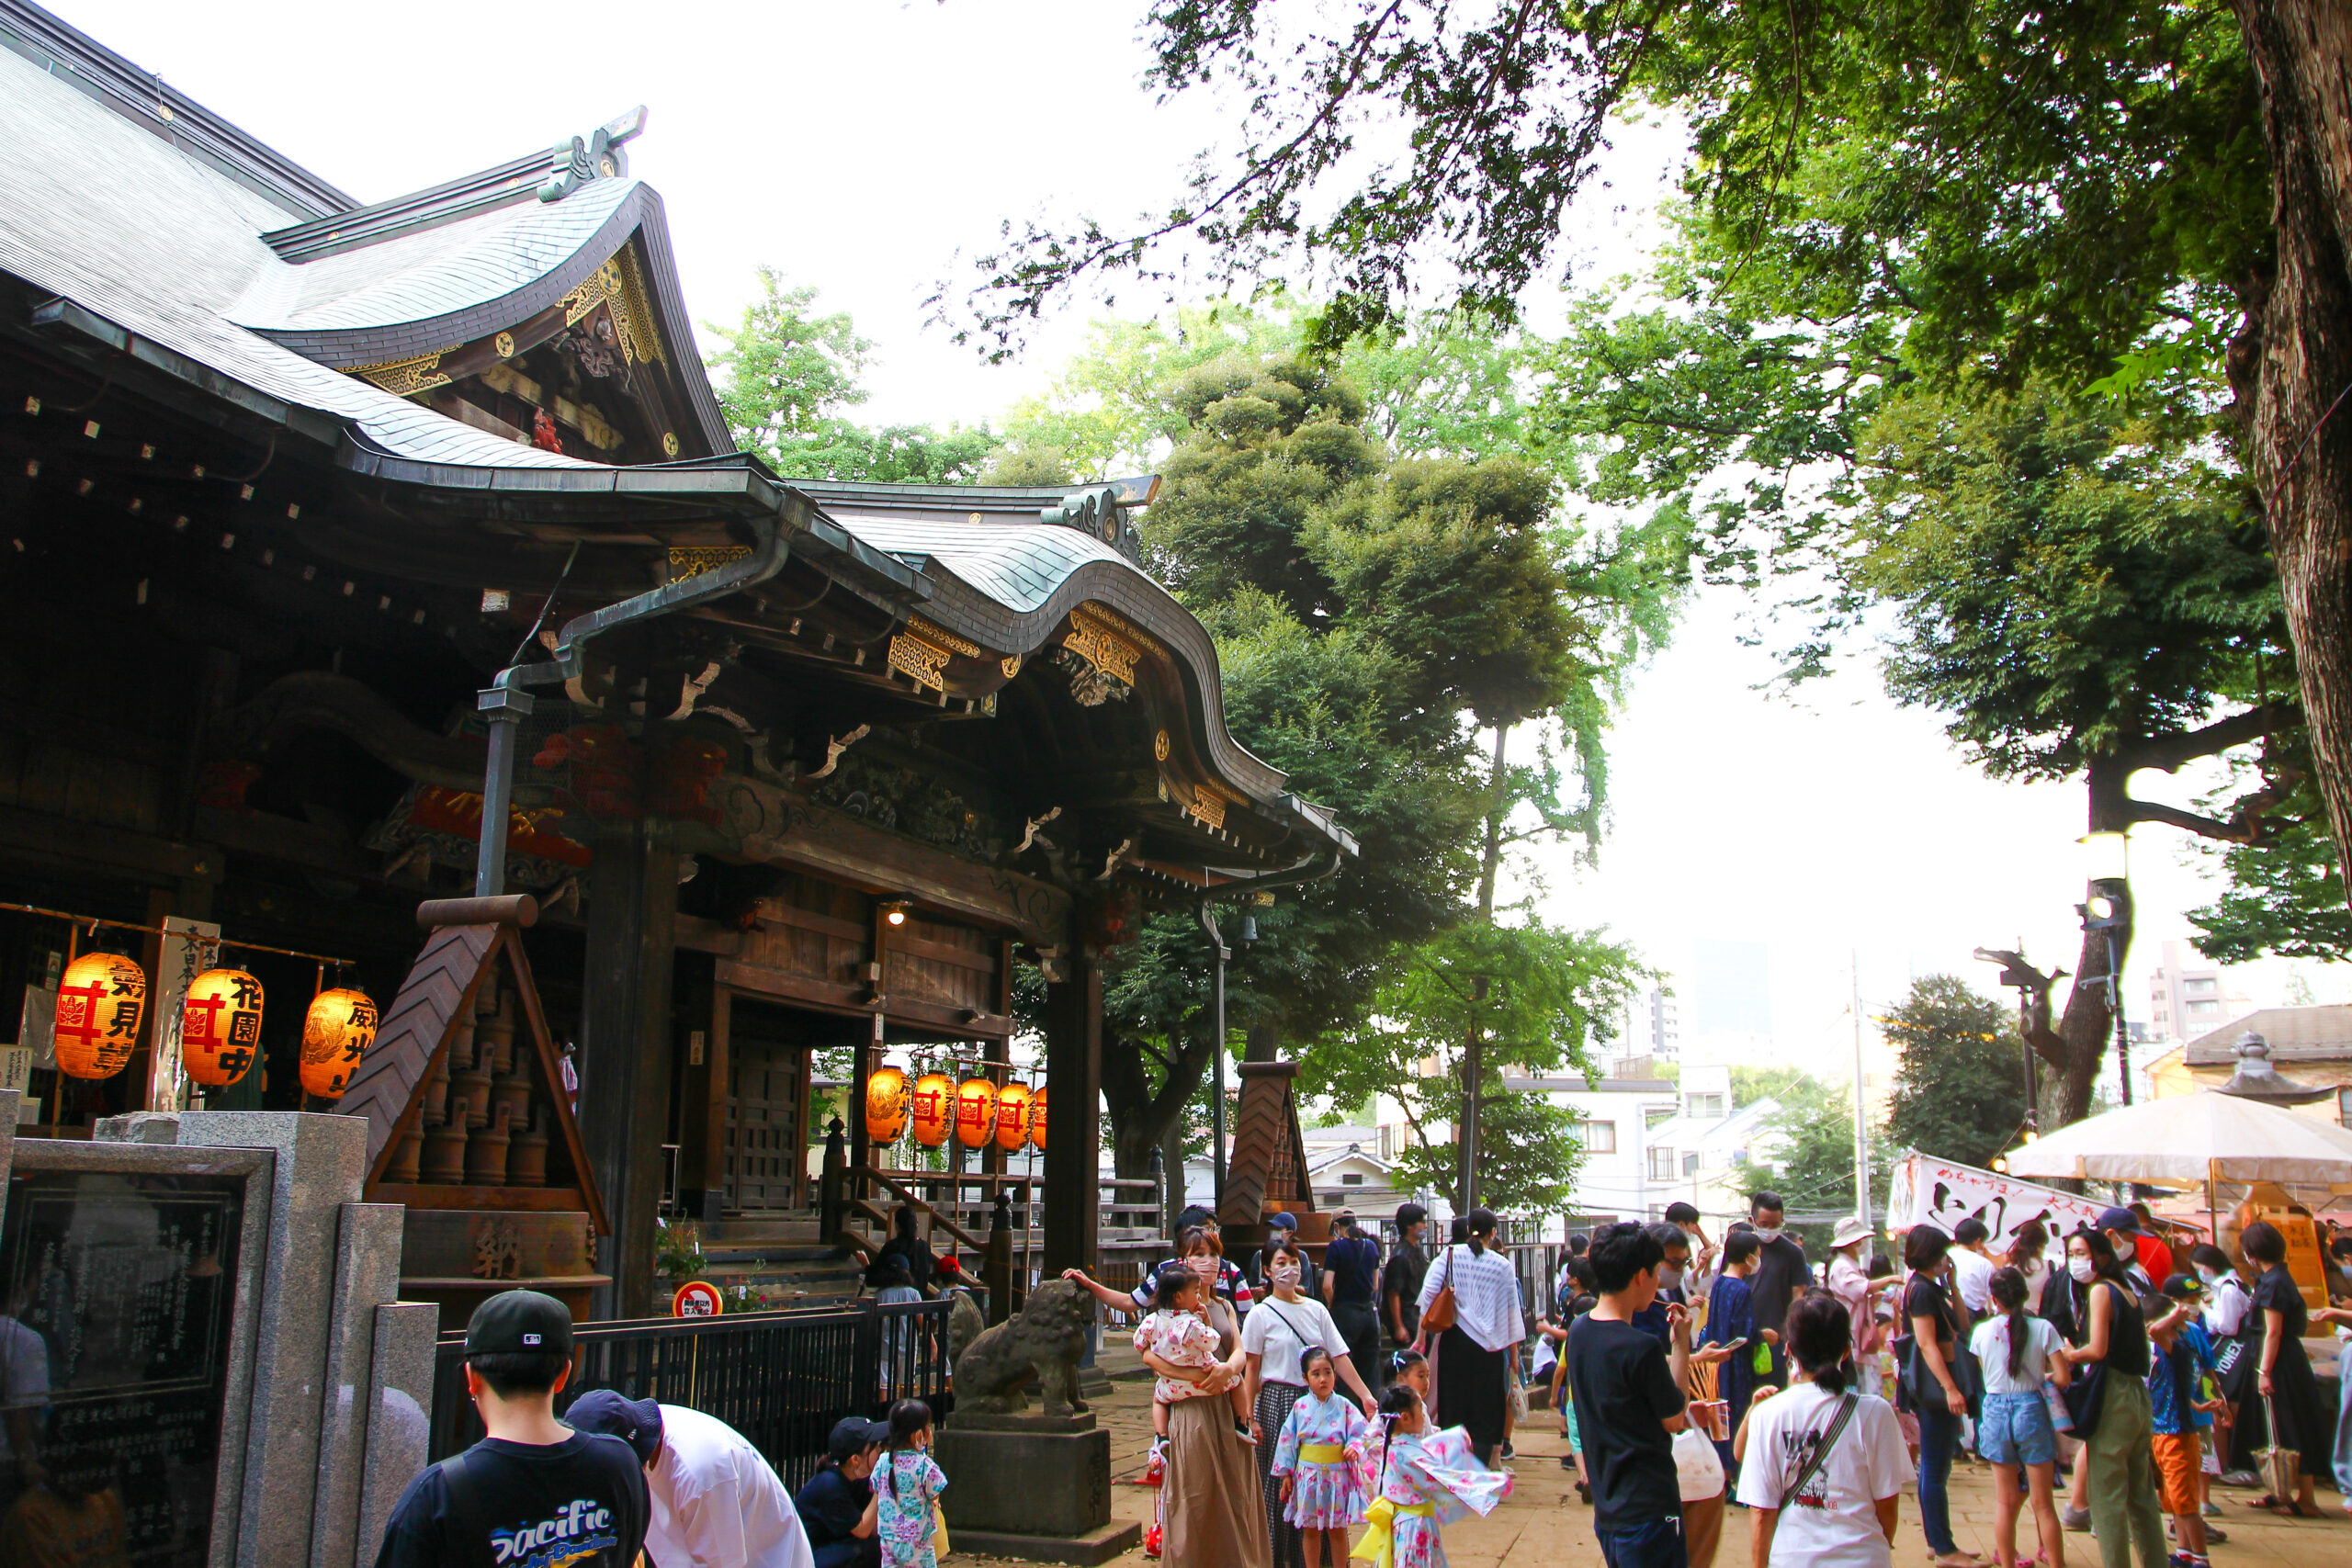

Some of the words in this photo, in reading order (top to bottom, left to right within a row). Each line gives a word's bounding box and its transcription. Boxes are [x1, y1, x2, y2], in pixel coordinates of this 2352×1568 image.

[219, 976, 262, 1081] 花園中
[2214, 1338, 2245, 1375] YONEX
